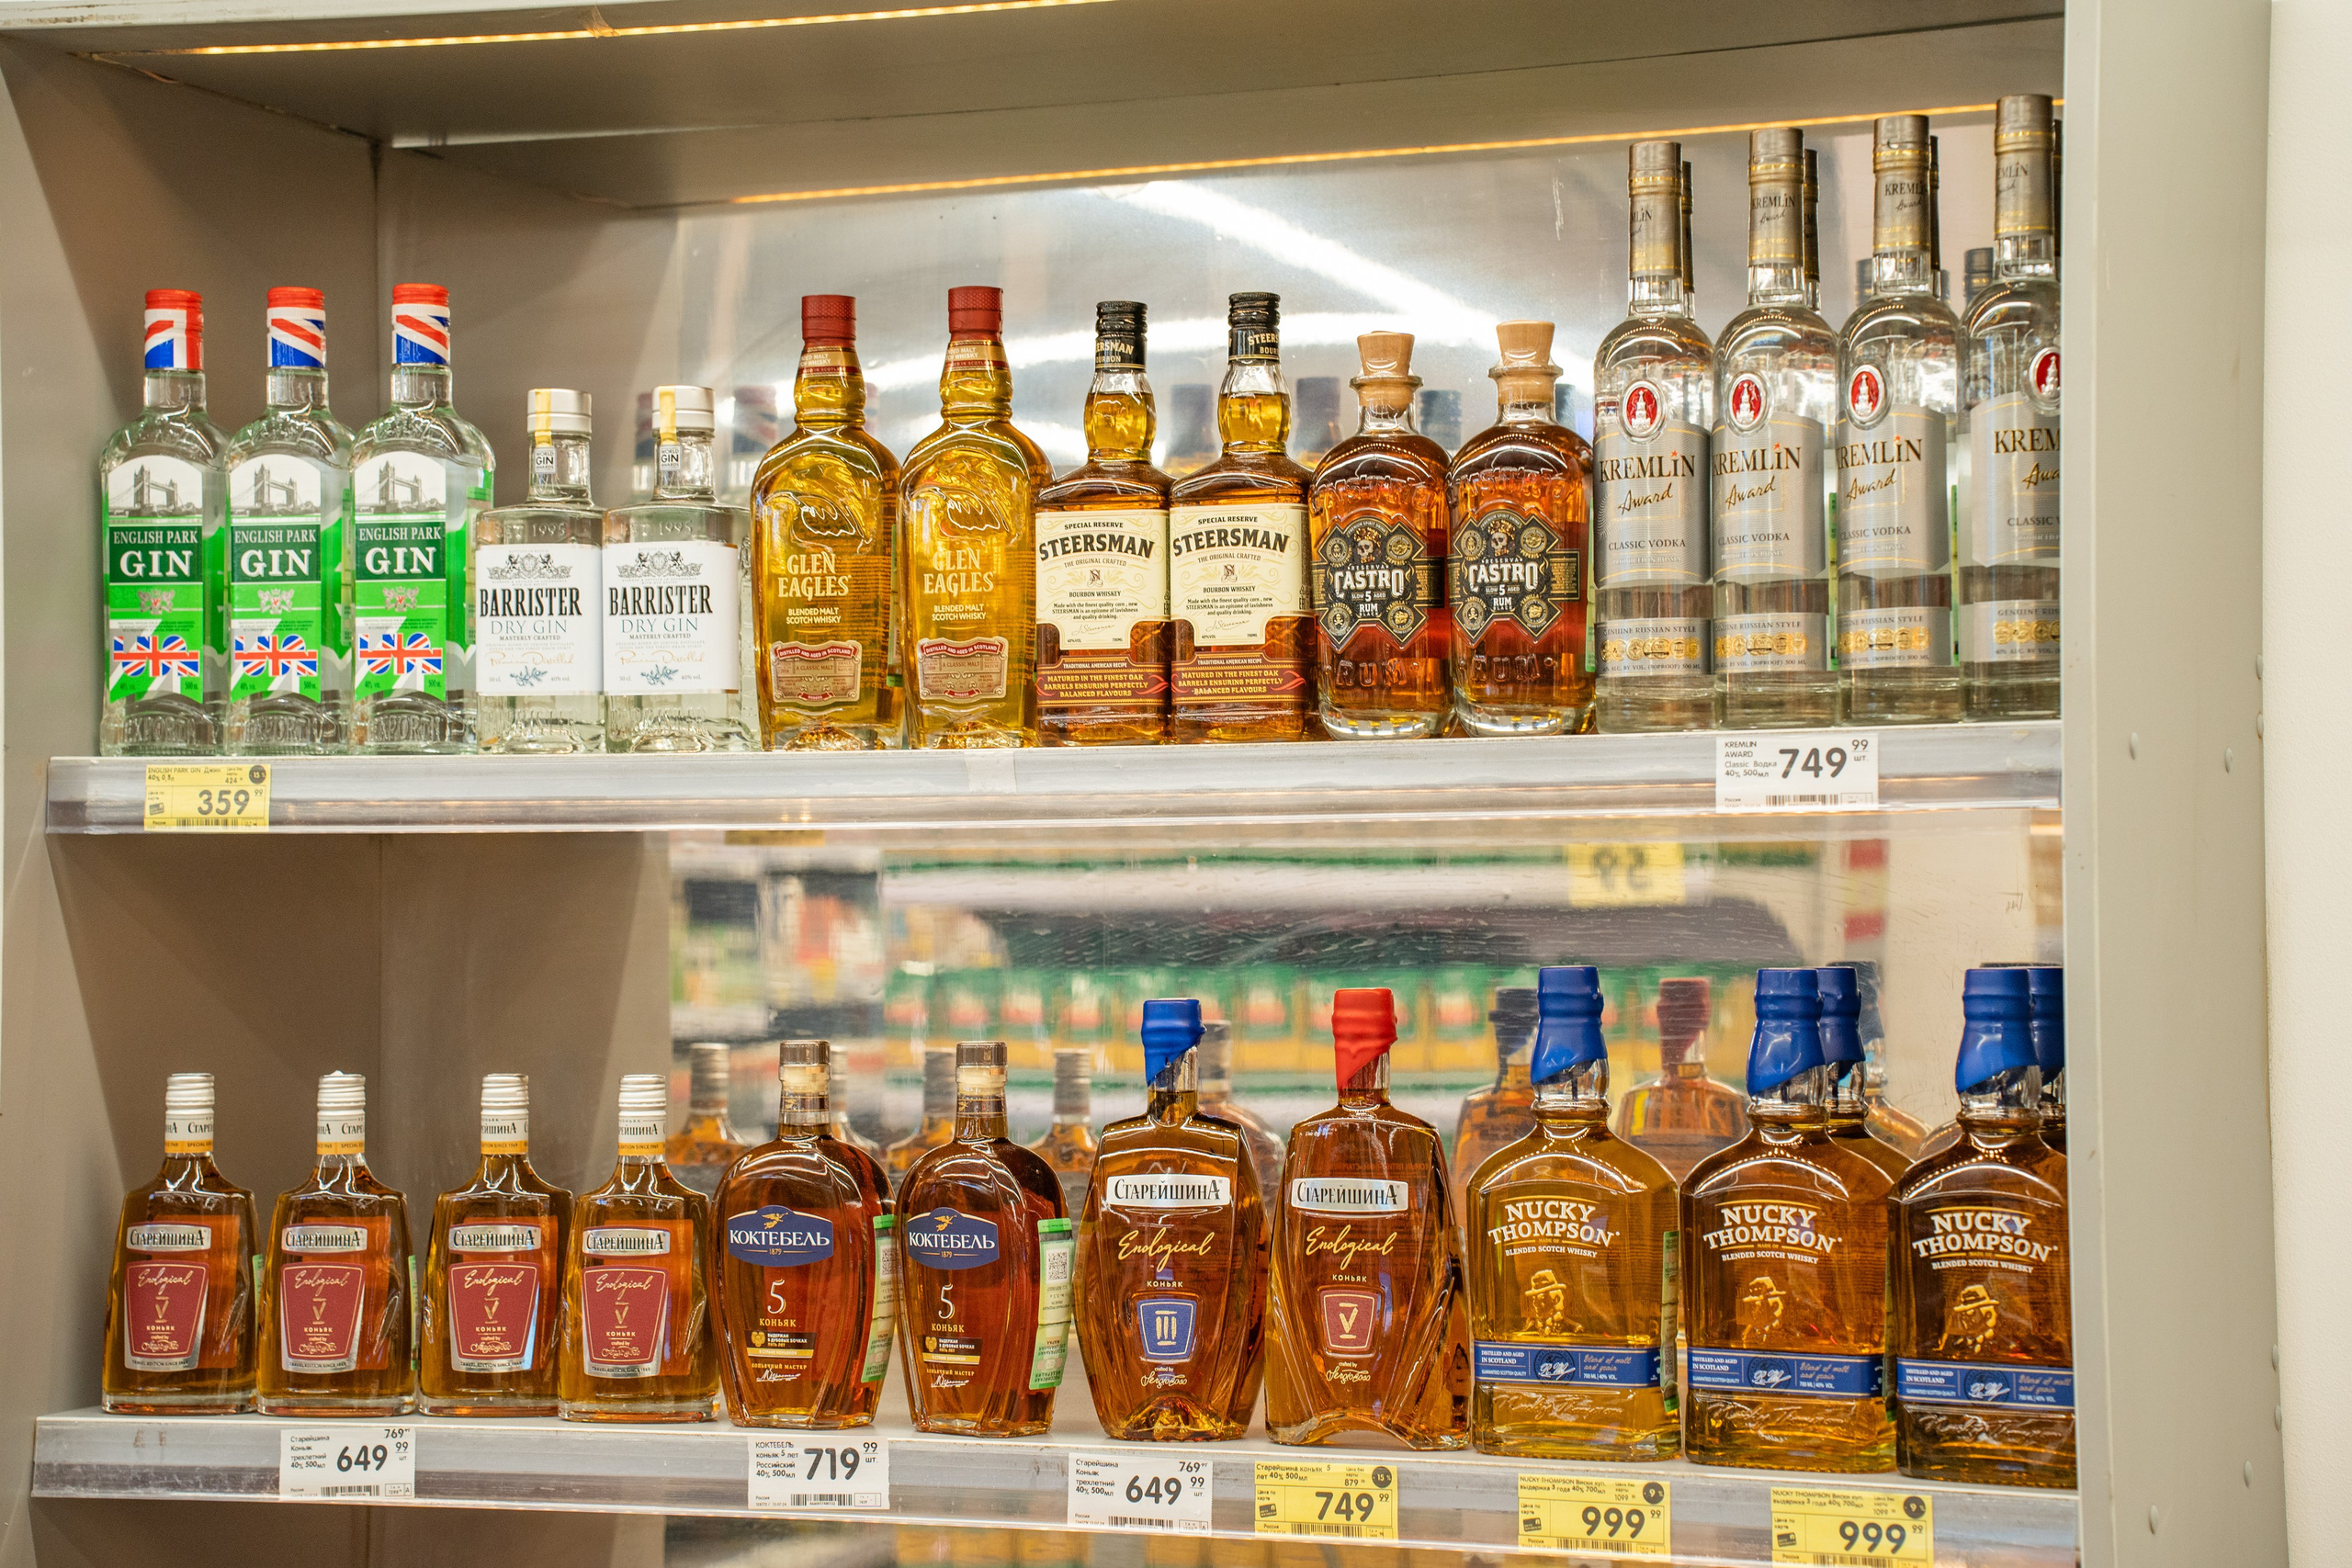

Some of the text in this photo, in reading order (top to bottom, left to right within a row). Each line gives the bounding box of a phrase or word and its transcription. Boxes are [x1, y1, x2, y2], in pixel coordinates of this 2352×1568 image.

[1759, 209, 1786, 225] Award
[1248, 333, 1278, 345] STEERS
[1994, 428, 2061, 455] KREM
[536, 457, 553, 465] GIN
[1725, 476, 1776, 510] Award
[1847, 468, 1896, 502] Award
[1618, 482, 1673, 515] Award
[114, 530, 198, 544] ENGLISH PARK
[235, 529, 316, 543] ENGLISH PARK
[359, 526, 441, 540] ENGLISH PARK
[533, 524, 567, 537] 1995
[1039, 534, 1155, 562] STEERSMAN
[1173, 528, 1291, 557] STEERSMAN
[1608, 538, 1686, 550] CLASSIC VODKA
[119, 550, 193, 577] GIN
[240, 549, 311, 577] GIN
[365, 547, 436, 575] GIN
[786, 551, 836, 575] GLEN
[933, 547, 980, 571] GLEN
[778, 575, 849, 602] EAGLES
[923, 571, 994, 597] EAGLES
[1334, 570, 1405, 598] CASTRO
[1469, 562, 1539, 592] CASTRO
[609, 585, 713, 616] BARRISTER
[1365, 591, 1372, 602] 5
[1498, 584, 1505, 595] 5
[480, 587, 582, 617] BARRISTER
[788, 608, 819, 616] BLENDED
[934, 604, 964, 613] BLENDED
[1359, 604, 1378, 613] RUM
[1493, 597, 1511, 606] RUM
[492, 620, 567, 635] DRY GIN
[622, 617, 698, 633] DRY GIN
[814, 615, 842, 624] WHISKY
[932, 612, 986, 621] SCOTCH WHISKY
[1602, 626, 1634, 636] GENUINE
[1635, 626, 1670, 634] RUSSIAN
[1178, 679, 1208, 687] BARRELS
[1851, 739, 1869, 750] 99
[1724, 770, 1740, 778] 40%
[1779, 747, 1847, 779] 749
[198, 789, 250, 816] 359
[1114, 1179, 1221, 1201] СТАРЕЙШИНА
[1296, 1182, 1398, 1207] СТАРЕЙШИНА
[1505, 1201, 1596, 1224] NUCKY
[1721, 1204, 1818, 1228] NUCKY
[1930, 1212, 2031, 1236] NUCKY
[729, 1230, 830, 1247] КОКТЕБЕЛЬ
[909, 1232, 995, 1249] КОКТЕБЕЛЬ
[1487, 1221, 1614, 1248] THOMPSON
[1703, 1225, 1836, 1254] THOMPSON
[1118, 1224, 1216, 1272] Enological
[1306, 1224, 1398, 1271] Enological
[1505, 1246, 1598, 1258] BLENDED SCOTCH WHISKY
[1722, 1250, 1819, 1265] BLENDED SCOTCH WHISKY
[1912, 1234, 2052, 1263] THOMPSON
[138, 1267, 193, 1295] Enological
[295, 1269, 347, 1297] Enological
[464, 1268, 524, 1296] Enological
[595, 1272, 653, 1300] Enological
[1147, 1280, 1184, 1288] КОНЬЯК
[1332, 1273, 1368, 1283] КОНЬЯК
[938, 1283, 956, 1319] 5
[759, 1318, 797, 1327] КОНЬЯК
[932, 1323, 965, 1332] КОНЬЯК
[384, 1428, 404, 1438] 769
[395, 1441, 409, 1452] 99
[863, 1442, 877, 1453] 99
[336, 1445, 388, 1472] 649
[804, 1447, 860, 1480] 719
[1076, 1459, 1119, 1468] Старейшина
[773, 1470, 796, 1478] 500мл
[1125, 1475, 1182, 1506] 649
[1379, 1494, 1389, 1502] 99
[1315, 1492, 1374, 1522] 749
[1650, 1510, 1661, 1518] 99
[1581, 1506, 1645, 1539] 999
[1839, 1520, 1906, 1554] 999
